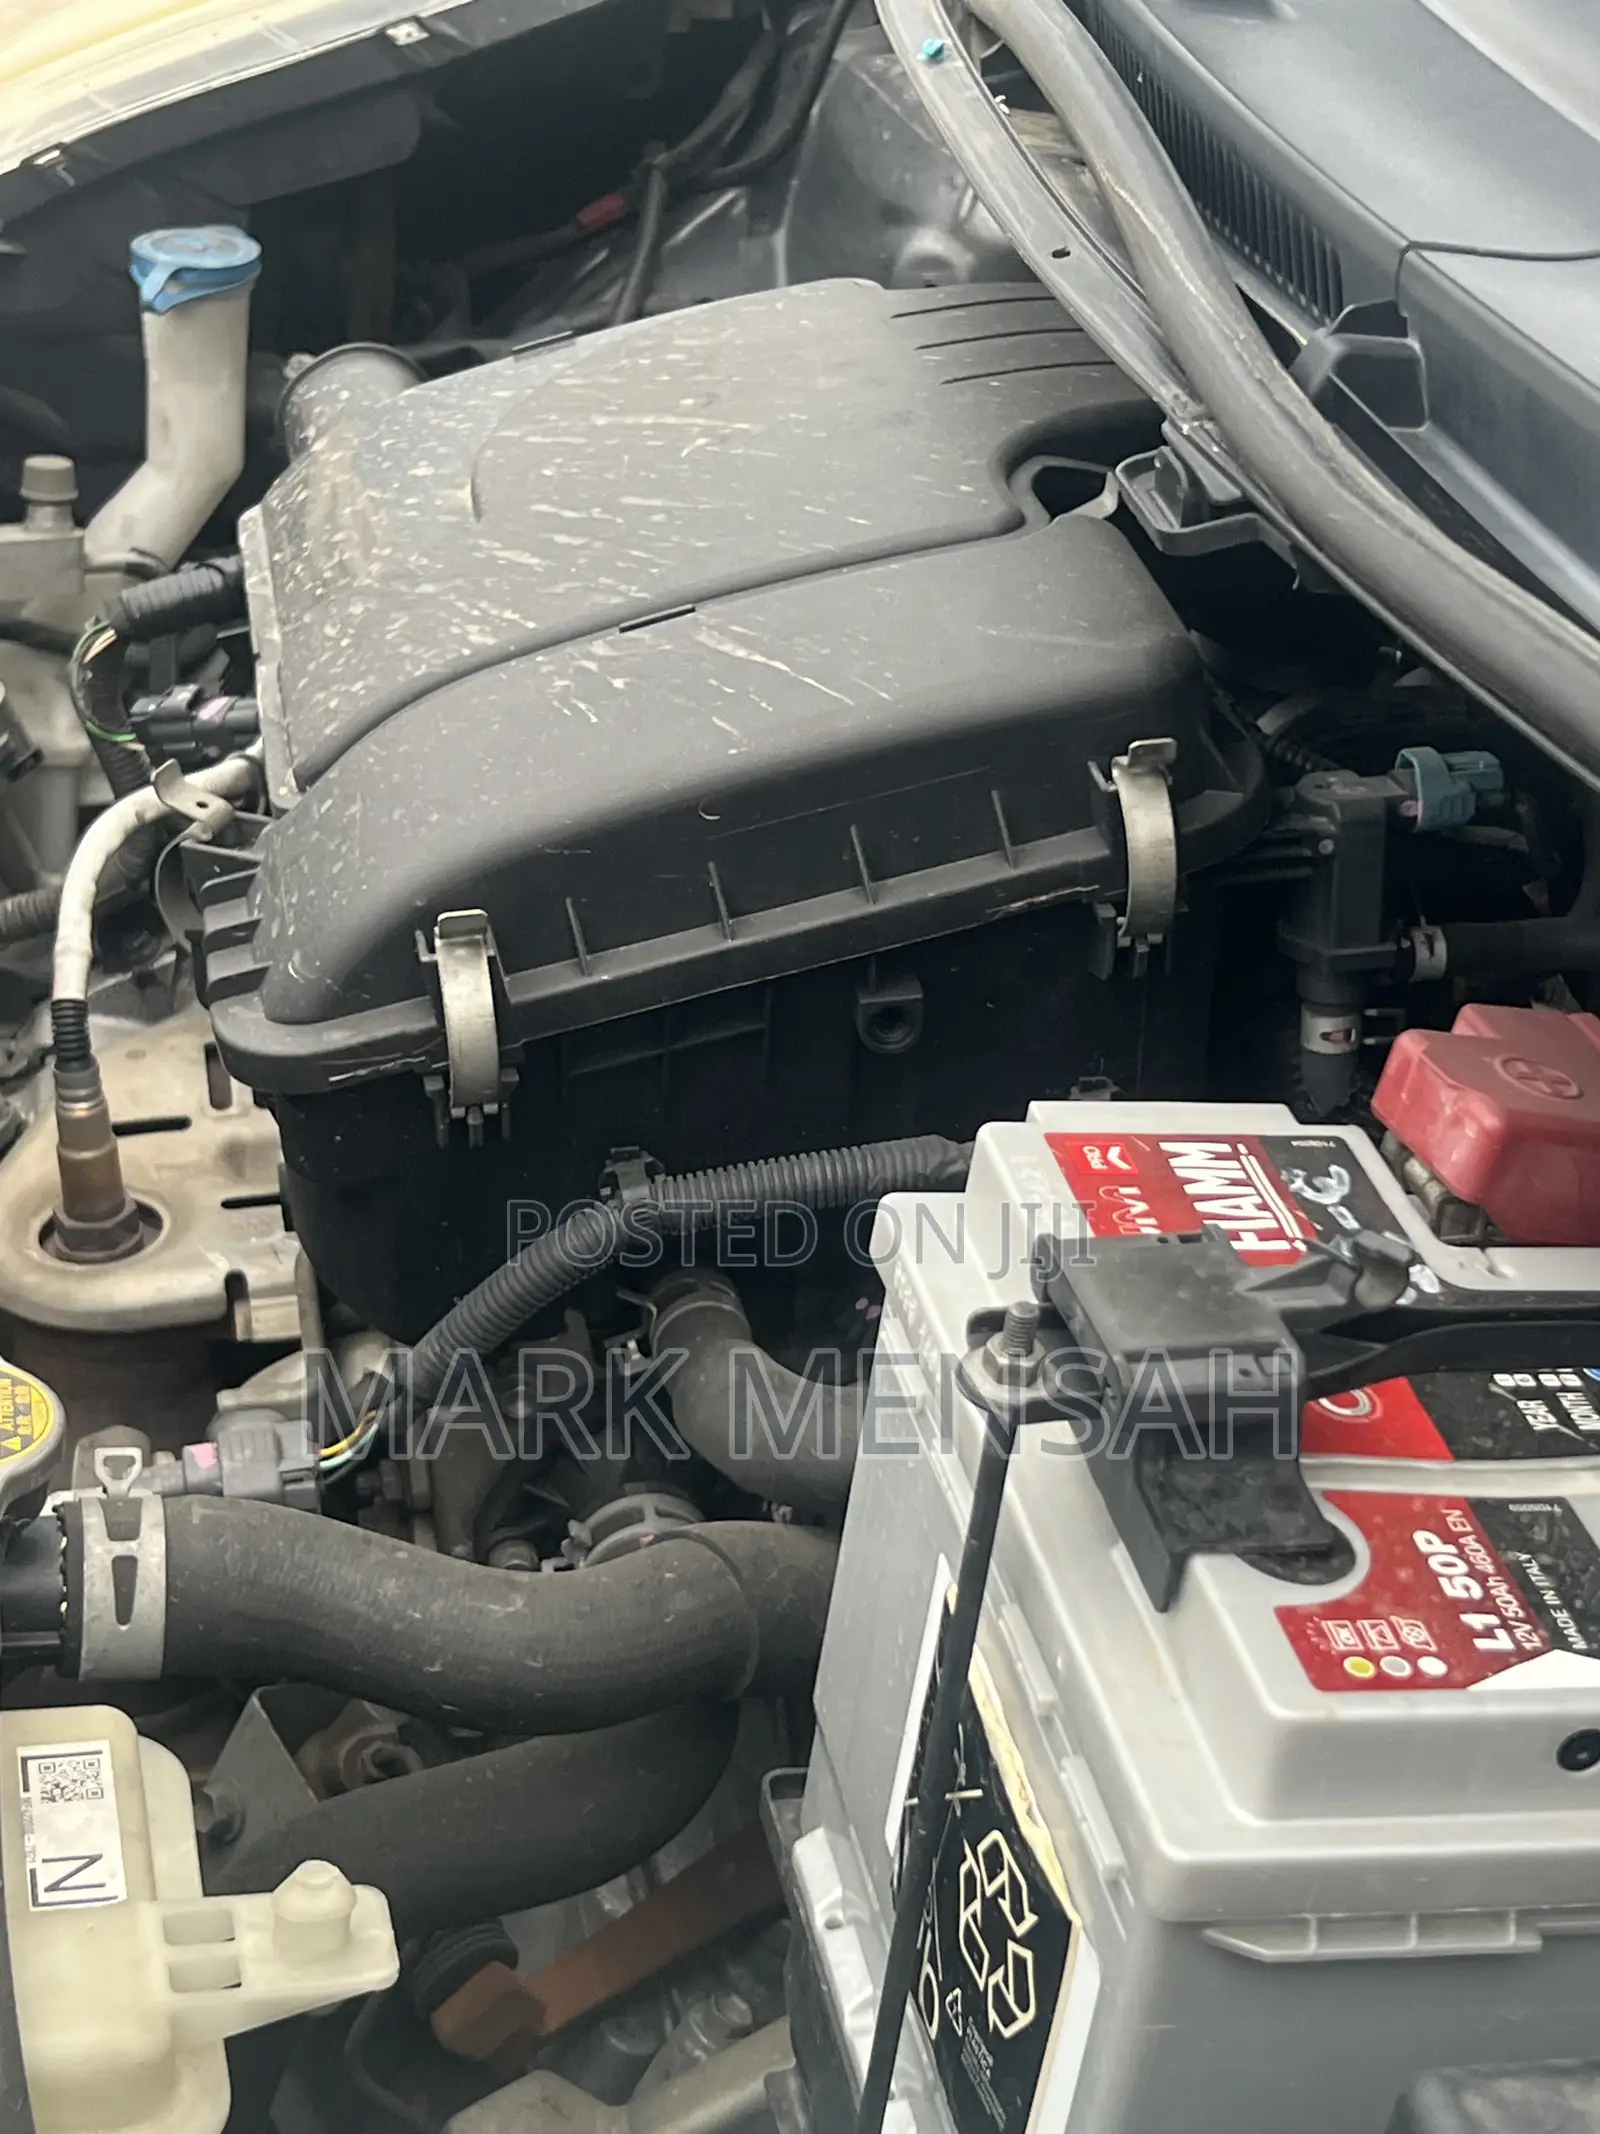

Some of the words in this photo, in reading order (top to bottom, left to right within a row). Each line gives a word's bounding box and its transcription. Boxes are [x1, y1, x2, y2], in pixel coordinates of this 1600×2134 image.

[1081, 1145, 1108, 1170] PRO
[1516, 1400, 1558, 1430] YEAR
[1441, 1508, 1474, 1532] EN
[1412, 1530, 1484, 1600] 50P
[1458, 1534, 1497, 1574] 460A
[1515, 1551, 1547, 1587] ITALY
[1486, 1576, 1526, 1618] 50Ah
[1539, 1589, 1562, 1605] IN
[1459, 1612, 1517, 1651] L1
[1508, 1619, 1543, 1651] 12V
[1550, 1608, 1588, 1650] MADE
